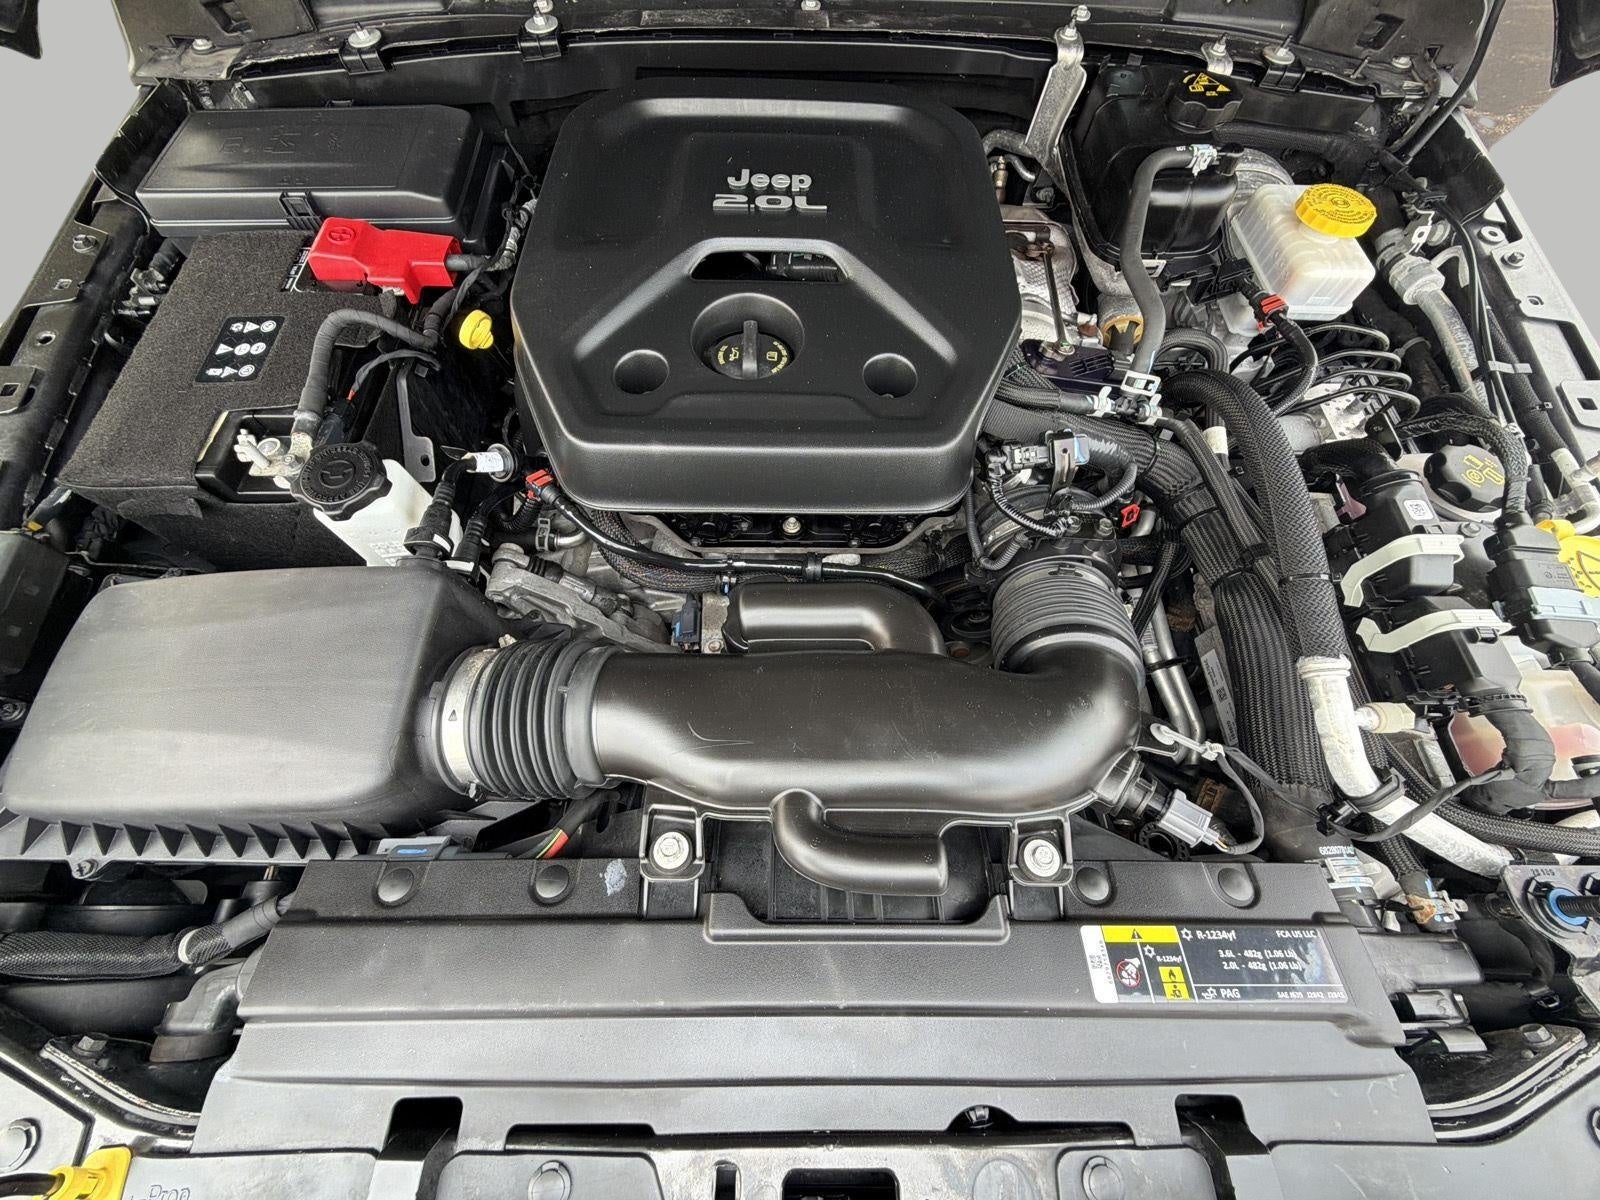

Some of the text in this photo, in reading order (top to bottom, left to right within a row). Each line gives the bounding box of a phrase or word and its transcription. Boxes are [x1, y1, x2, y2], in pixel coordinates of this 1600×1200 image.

[727, 168, 812, 192] Jeep
[712, 193, 828, 212] 2.0L
[1196, 929, 1237, 941] R-1234yf
[1275, 930, 1318, 938] FCA US LLC
[1156, 955, 1182, 963] R-1234yf
[1218, 949, 1236, 958] 3.6L
[1244, 949, 1263, 959] 482g
[1264, 949, 1284, 959] (1.06
[1283, 949, 1298, 959] Lb)
[1222, 961, 1240, 970] 2.0L
[1248, 961, 1267, 971] 482g
[1268, 961, 1289, 971] (1.06
[1288, 961, 1303, 971] Lb)
[1220, 988, 1241, 999] PAG
